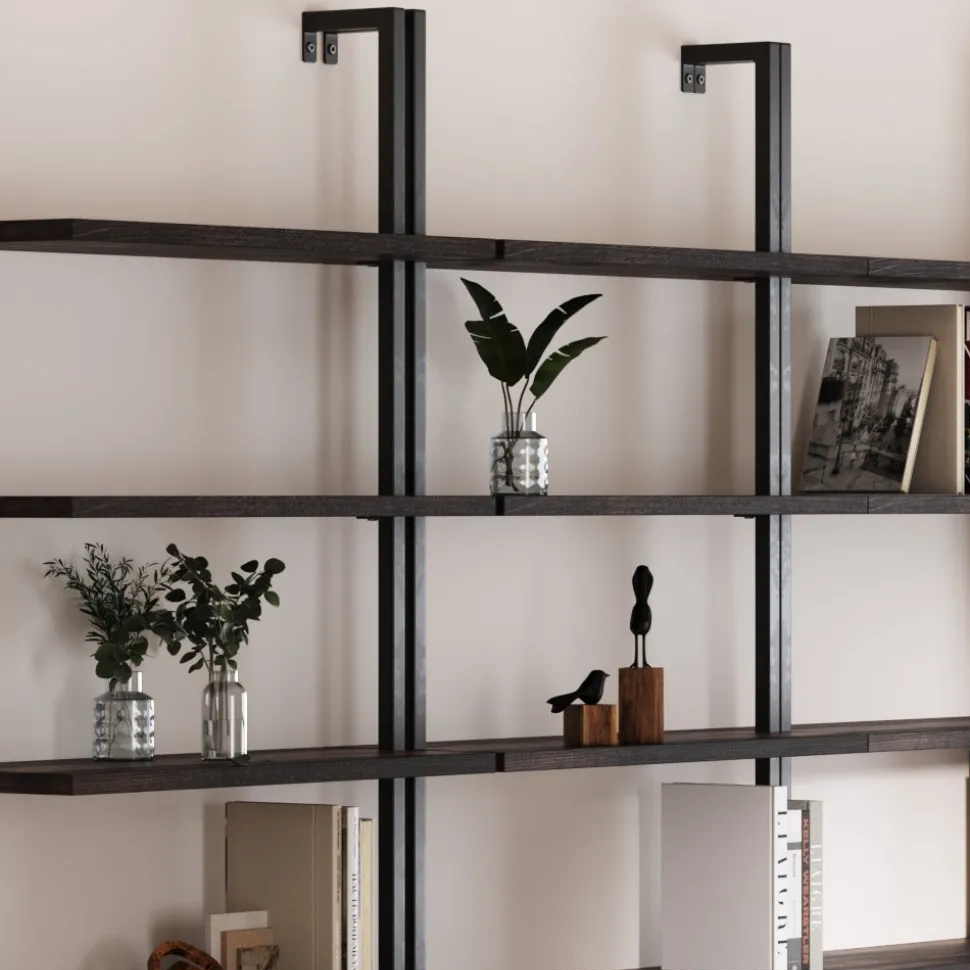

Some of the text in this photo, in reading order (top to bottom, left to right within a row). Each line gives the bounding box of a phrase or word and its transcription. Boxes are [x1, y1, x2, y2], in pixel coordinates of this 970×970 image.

[802, 818, 810, 966] KELLY WEARSTLER
[811, 844, 823, 932] LIAIGRE
